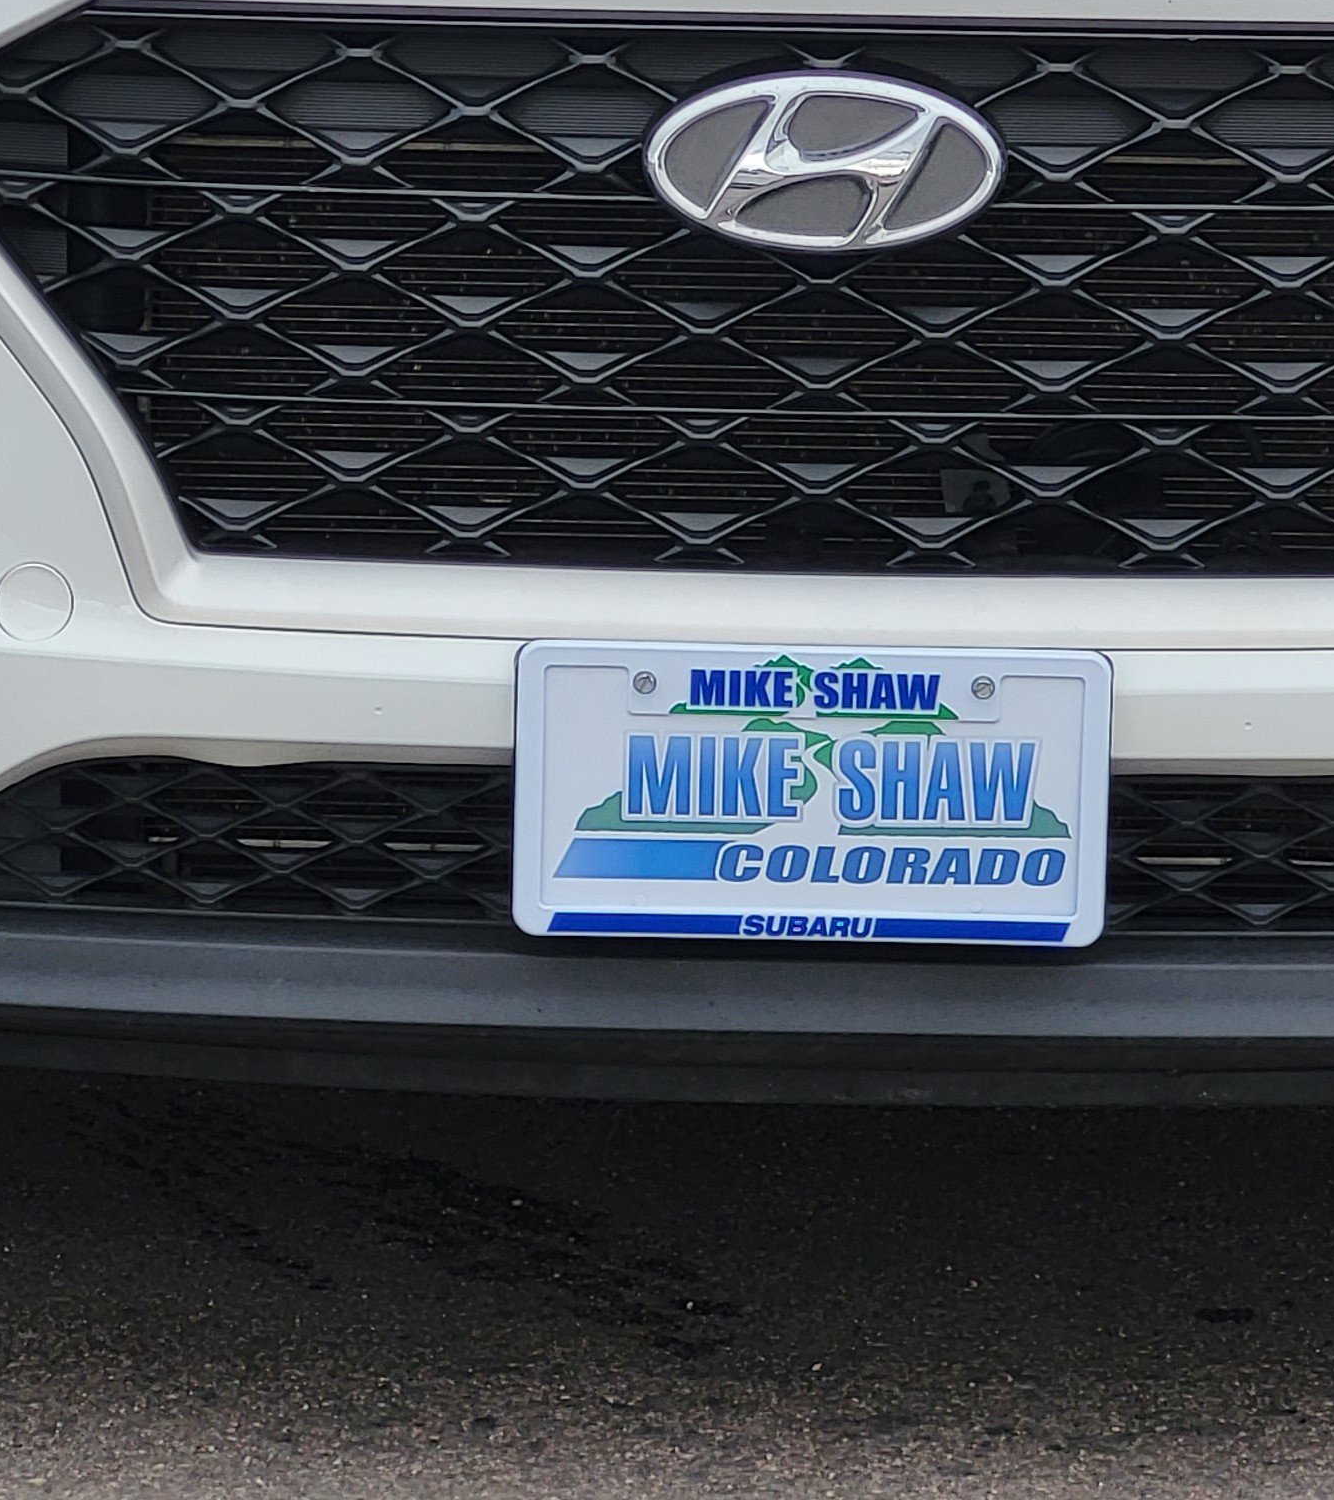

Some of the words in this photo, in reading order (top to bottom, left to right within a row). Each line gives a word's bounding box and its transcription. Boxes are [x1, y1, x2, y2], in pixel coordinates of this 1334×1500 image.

[689, 668, 794, 710] MIKE
[813, 671, 940, 712] SHAW
[625, 734, 800, 819] MIKE
[837, 738, 1037, 822] SHAW
[717, 843, 1067, 887] COLORADO
[739, 914, 873, 939] SUBARU
